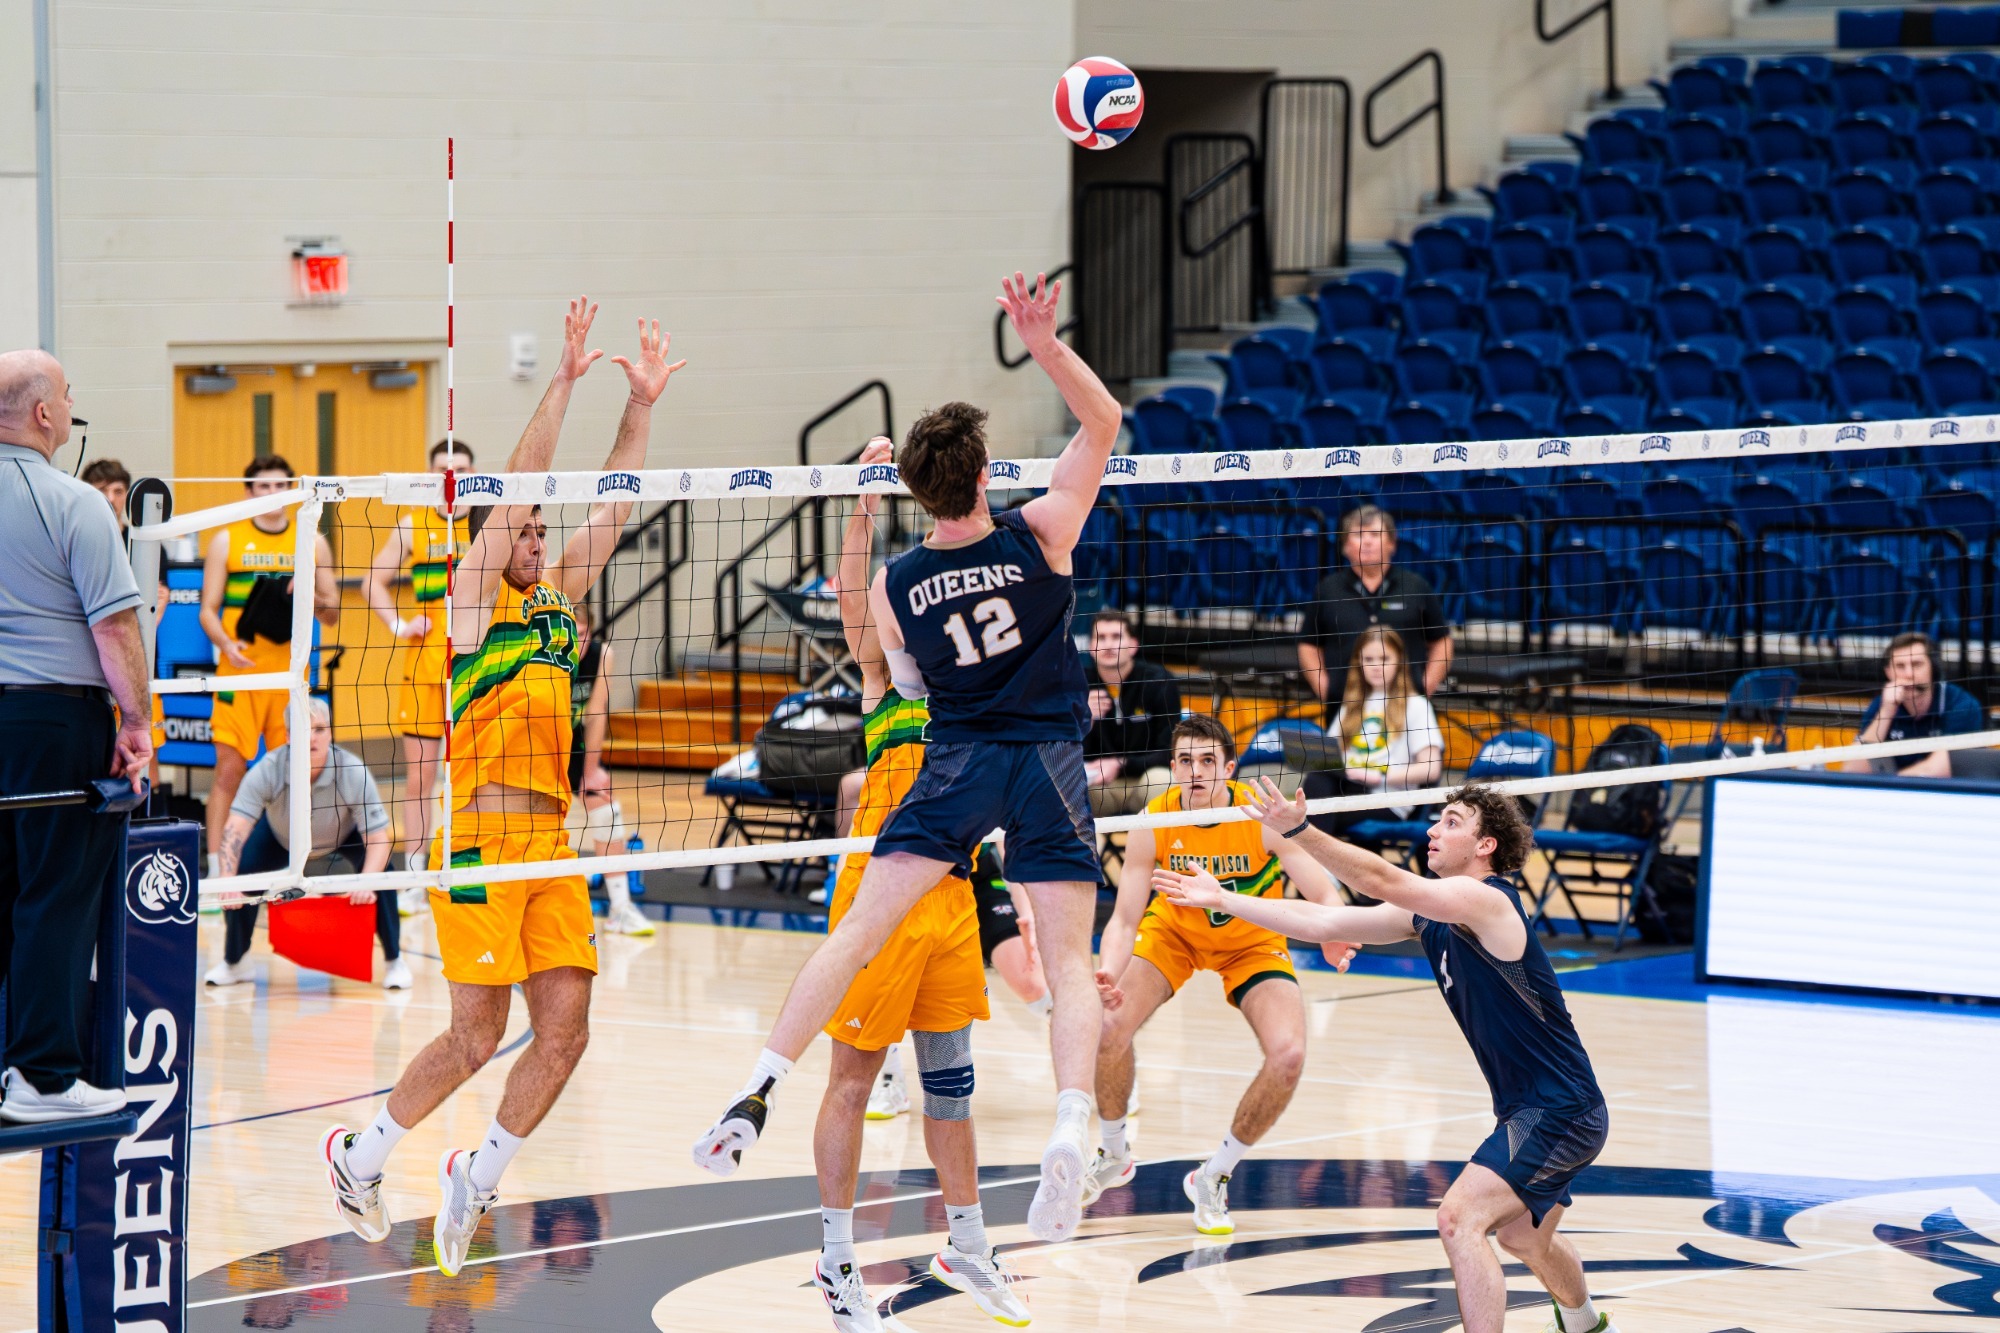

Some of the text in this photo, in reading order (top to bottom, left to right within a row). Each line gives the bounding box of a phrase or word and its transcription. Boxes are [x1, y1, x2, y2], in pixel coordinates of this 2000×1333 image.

[1109, 95, 1136, 106] NCAA
[458, 420, 1960, 497] QUEENS QUEENS QUEENS QUEENS UEENS UEENS QUEENS QUEENS QUEENS QUEENS QUEENS QUEENS QUEENS QUEENS
[908, 564, 1025, 616] QUEENS
[529, 614, 575, 673] 11
[943, 596, 1023, 667] 12
[1212, 854, 1251, 875] MASON
